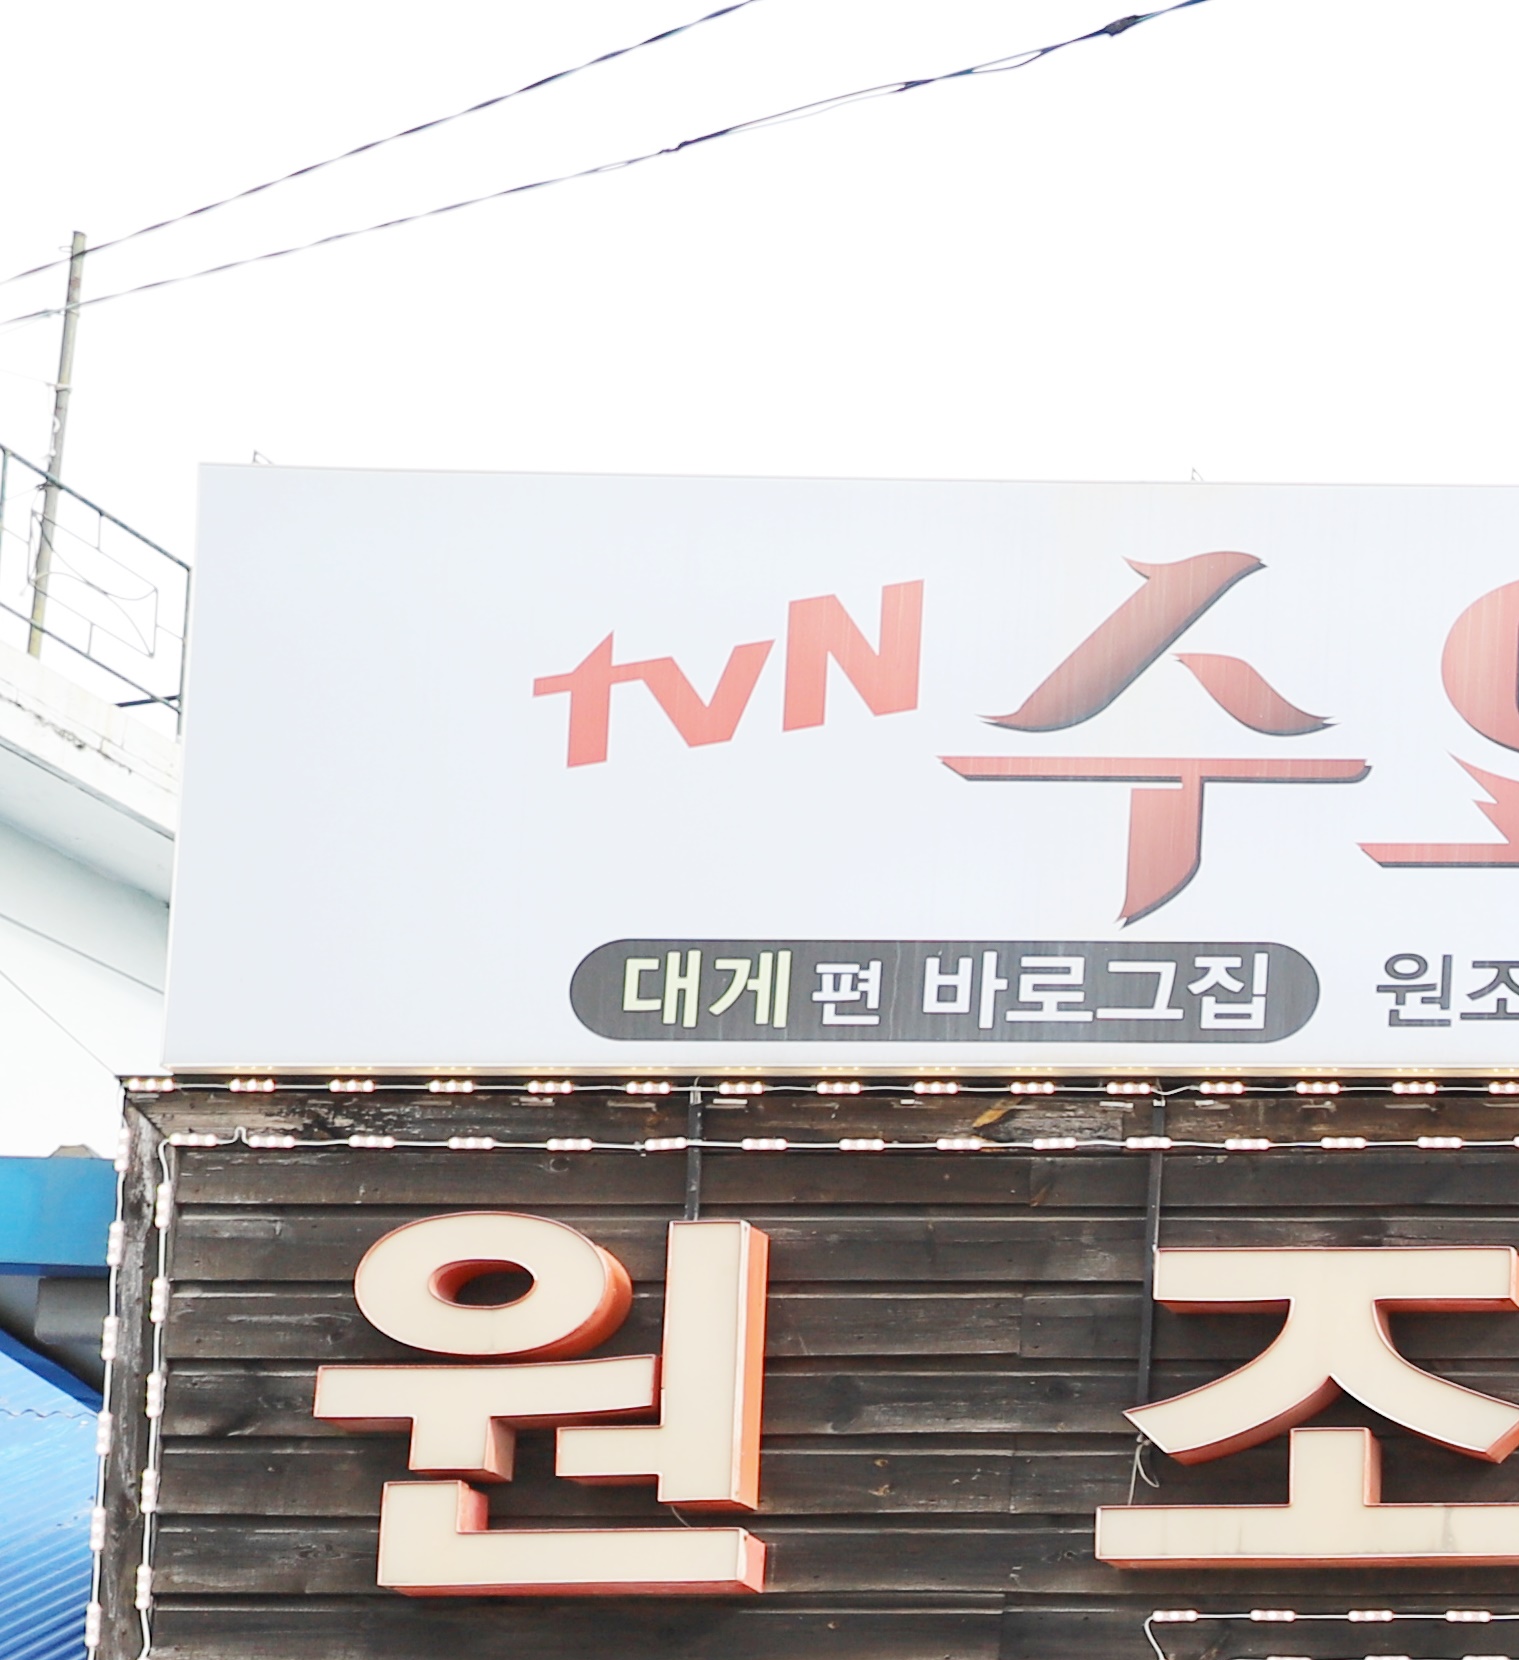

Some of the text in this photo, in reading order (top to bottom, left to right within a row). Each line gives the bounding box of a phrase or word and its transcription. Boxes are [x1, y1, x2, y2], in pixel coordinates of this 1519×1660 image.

[532, 578, 924, 769] tvN
[621, 949, 791, 1030] 대게
[810, 956, 885, 1027] 편
[919, 950, 1271, 1029] 바로그집
